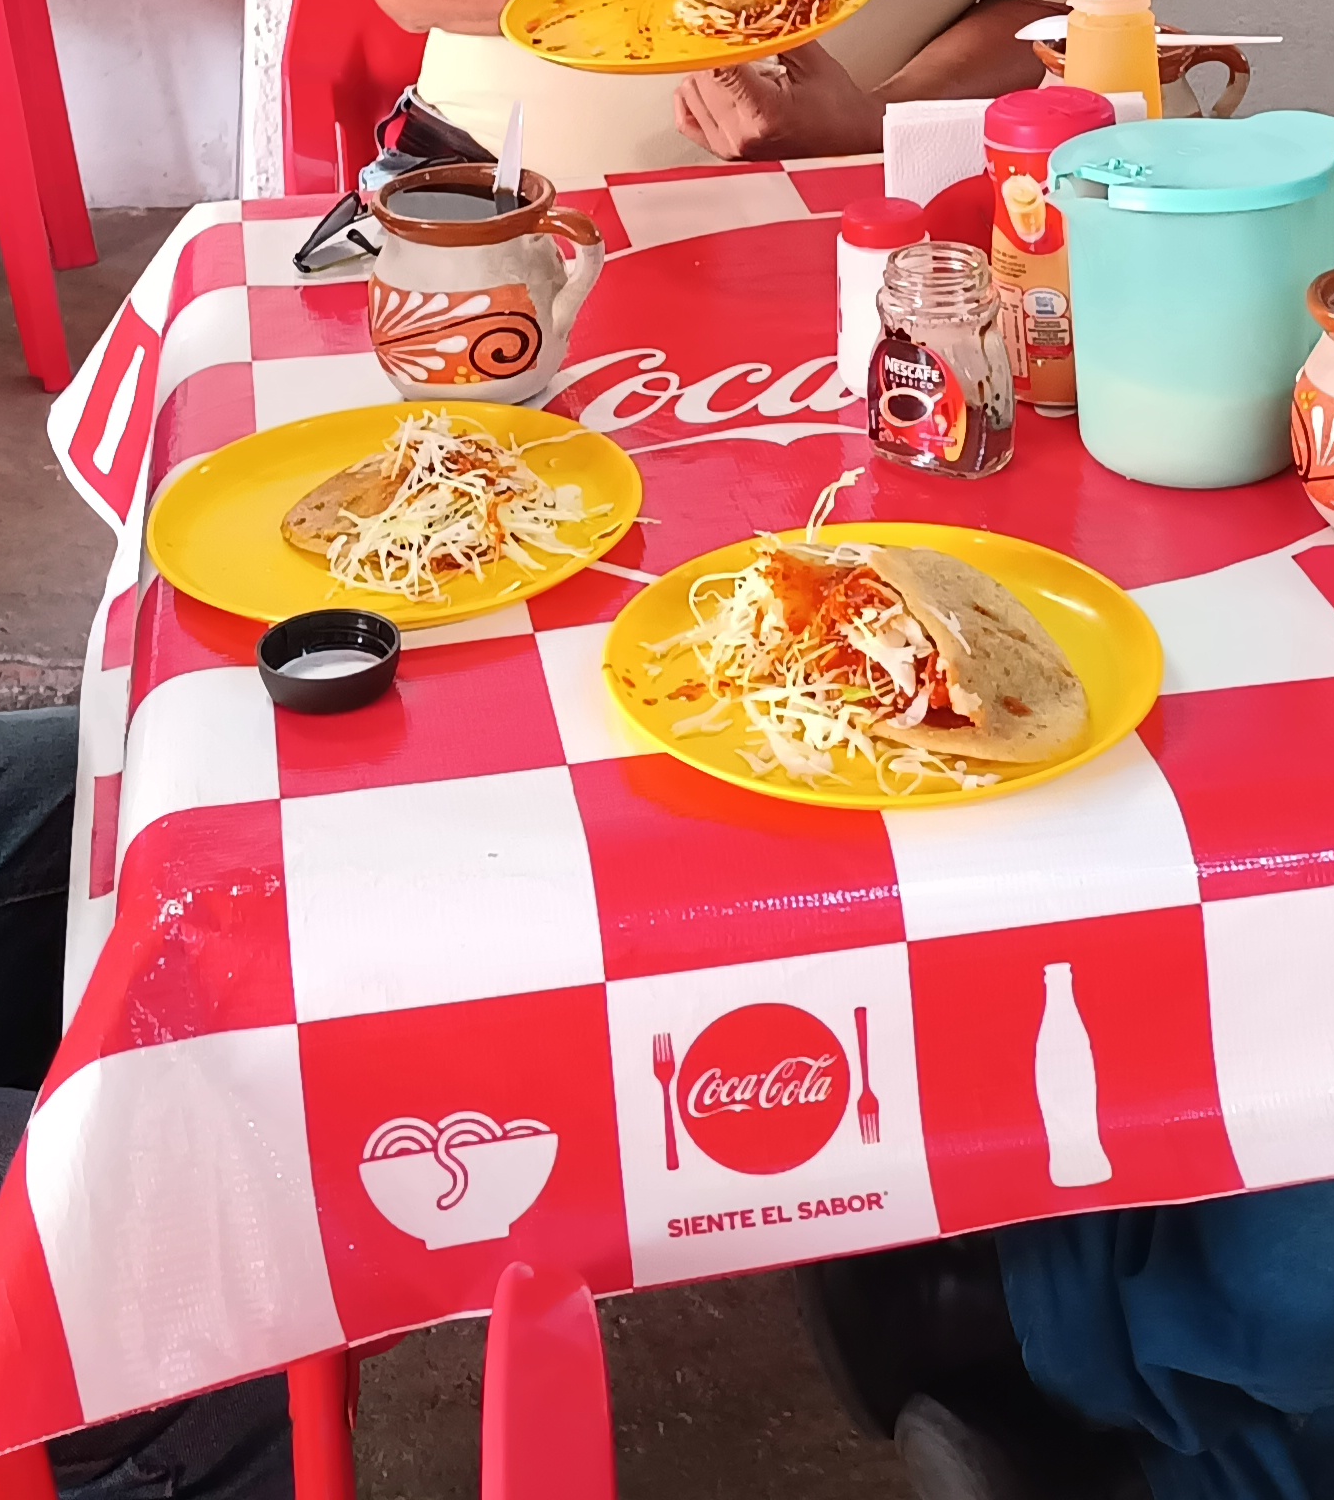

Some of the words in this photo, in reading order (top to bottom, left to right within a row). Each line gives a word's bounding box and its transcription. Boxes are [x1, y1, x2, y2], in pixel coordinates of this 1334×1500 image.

[667, 1208, 756, 1238] SIENTE
[762, 1205, 792, 1225] EL
[797, 1194, 883, 1221] SABOR
